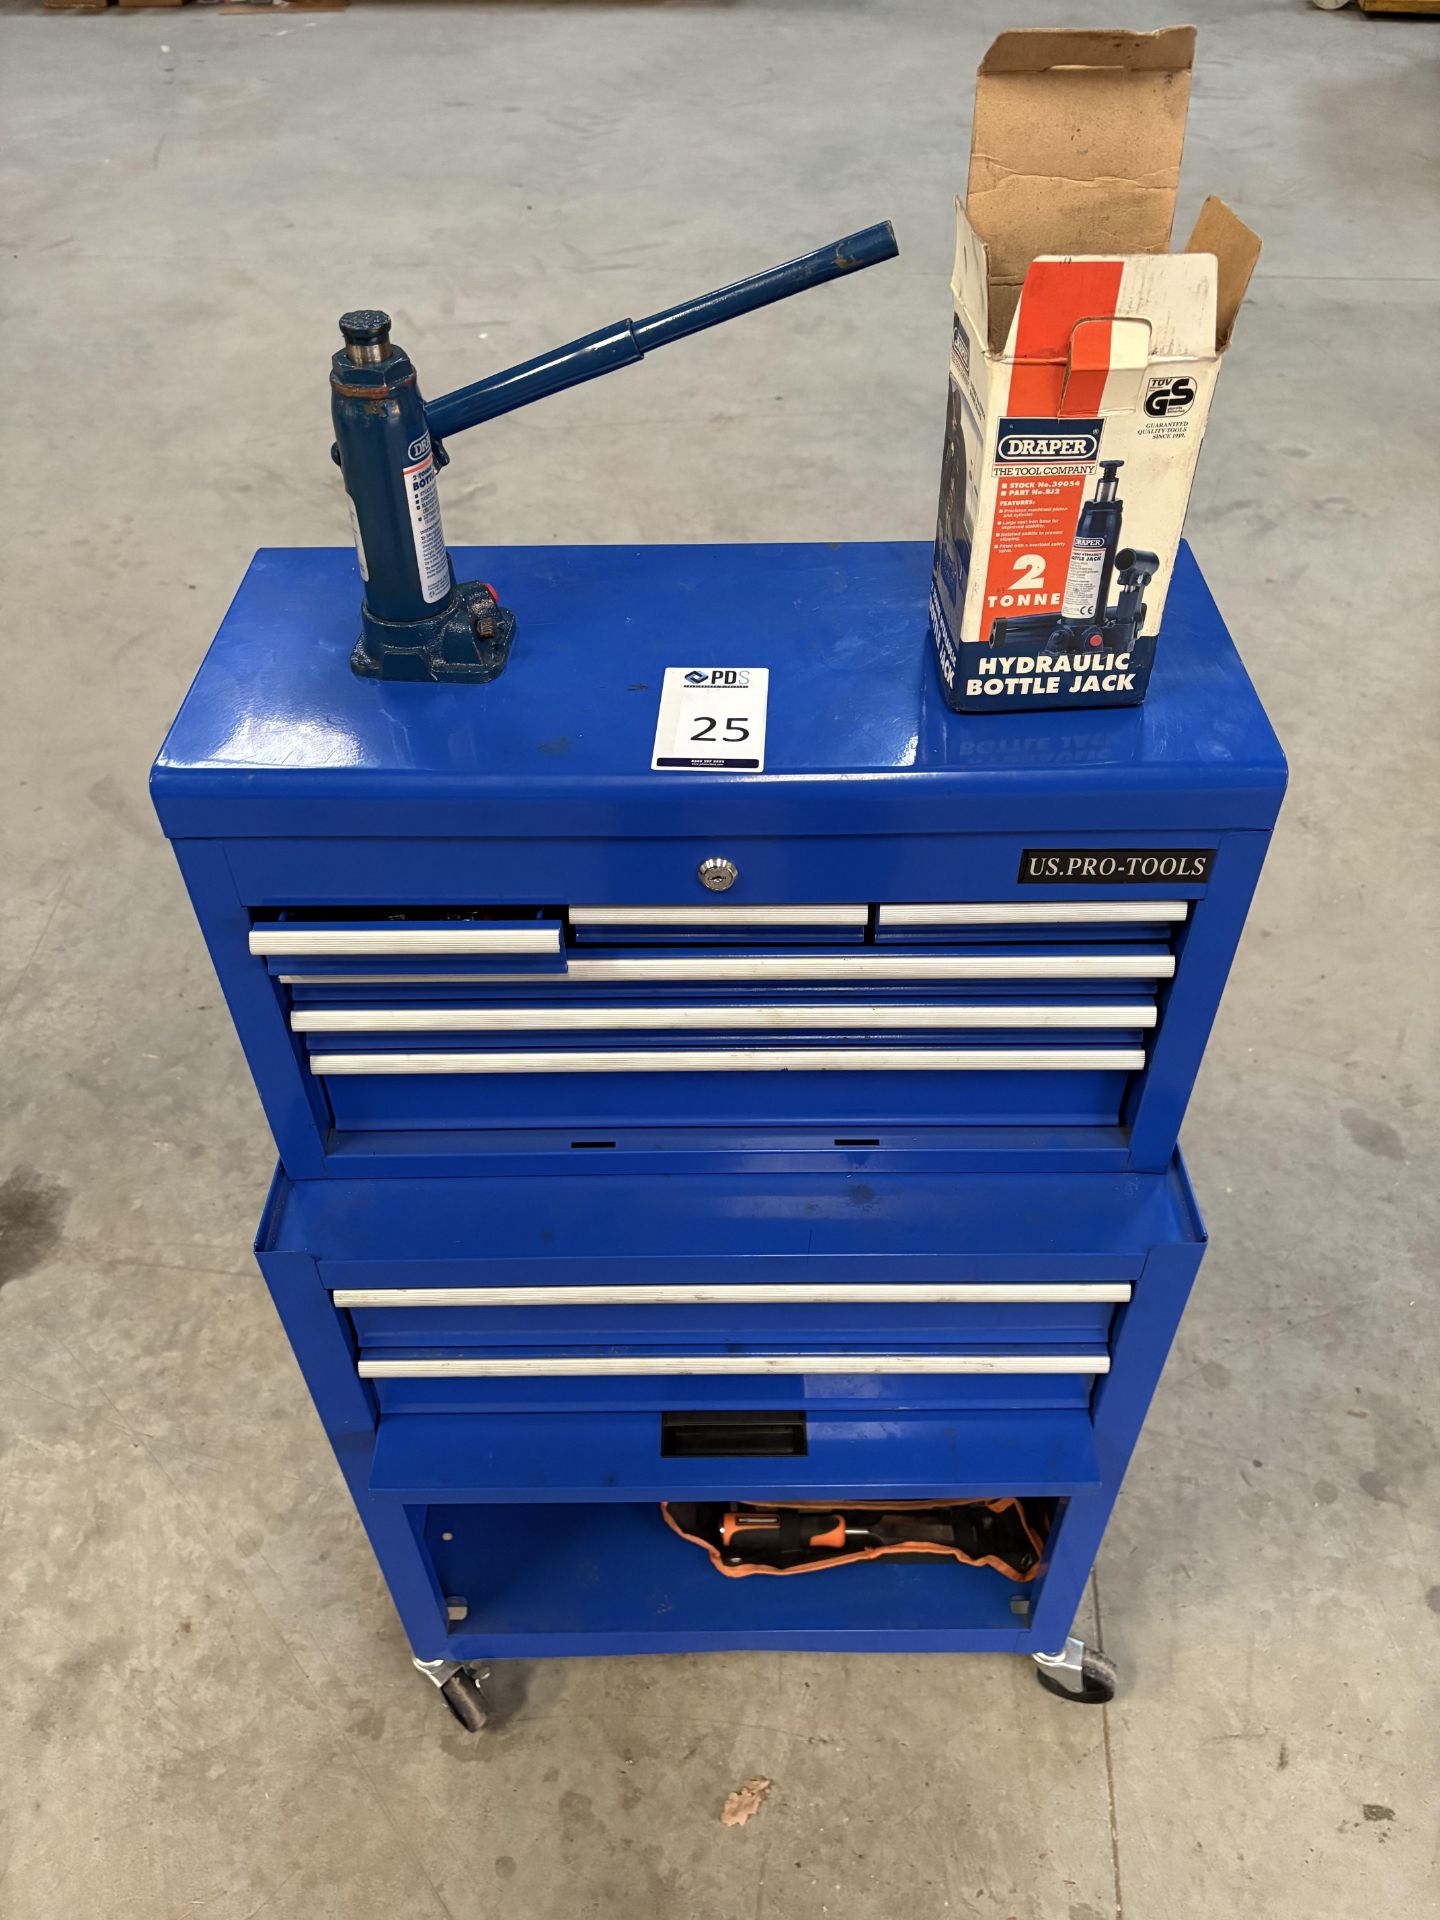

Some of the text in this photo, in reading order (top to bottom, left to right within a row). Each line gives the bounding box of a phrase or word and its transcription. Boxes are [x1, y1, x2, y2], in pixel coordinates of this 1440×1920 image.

[1146, 379, 1194, 416] GS
[1137, 426, 1187, 436] QUALITY TOOLS
[1145, 421, 1189, 429] GUARANTEED
[1007, 439, 1087, 455] DRAPER
[994, 465, 1096, 477] THE TOOL COMPANY
[1008, 554, 1046, 590] 2
[987, 592, 1061, 608] TONNE
[978, 652, 1130, 675] HYDRAULIC
[710, 670, 750, 685] PDS
[966, 673, 1136, 696] BOTTLE JACK
[690, 716, 750, 742] 25
[1029, 857, 1207, 876] US.PRO-TOOLS
